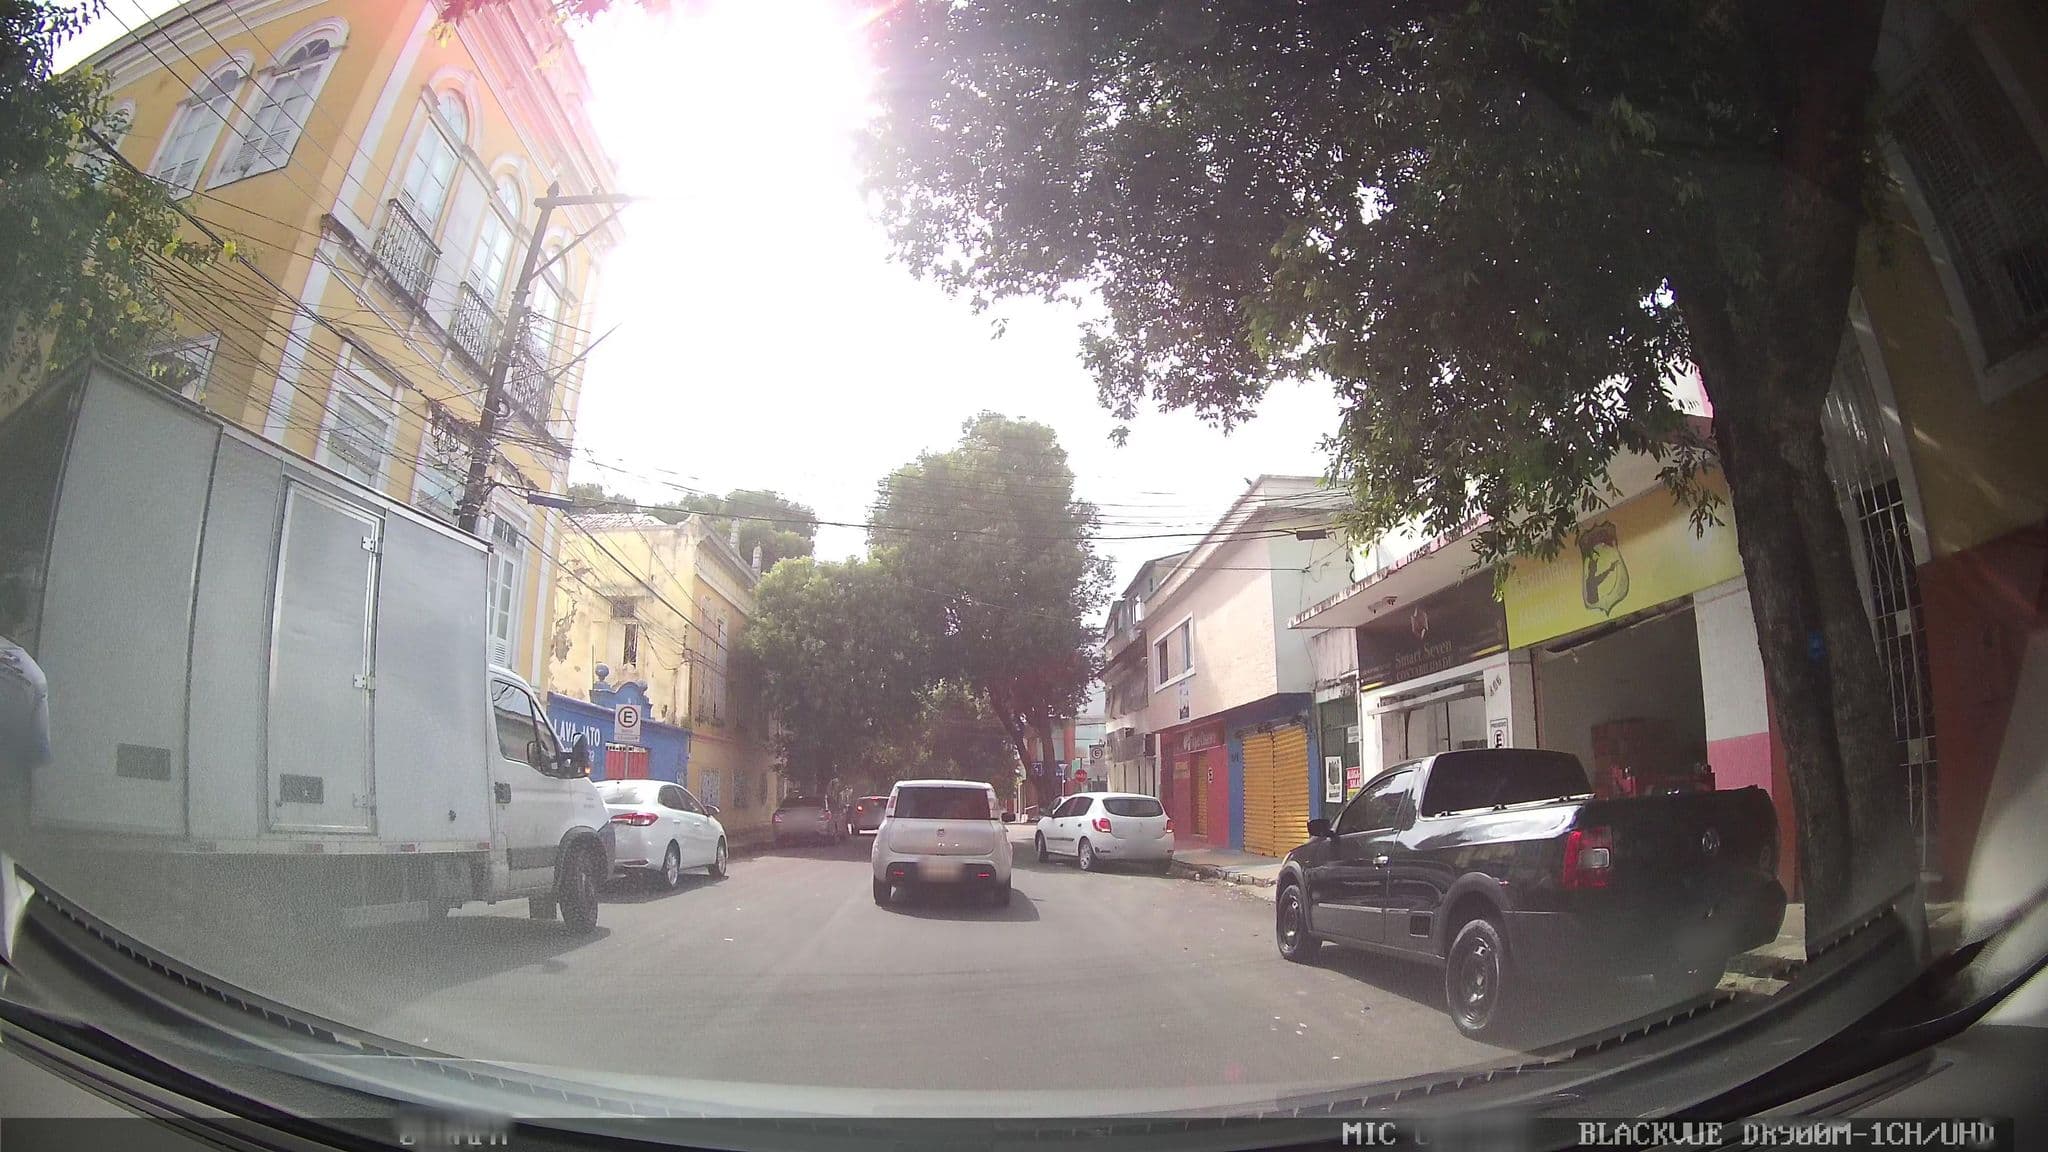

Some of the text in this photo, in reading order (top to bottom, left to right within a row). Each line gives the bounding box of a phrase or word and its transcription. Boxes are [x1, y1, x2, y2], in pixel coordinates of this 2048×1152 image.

[1423, 640, 1453, 658] Seven
[623, 711, 633, 724] E
[554, 719, 576, 742] LAVA
[1496, 733, 1502, 748] E
